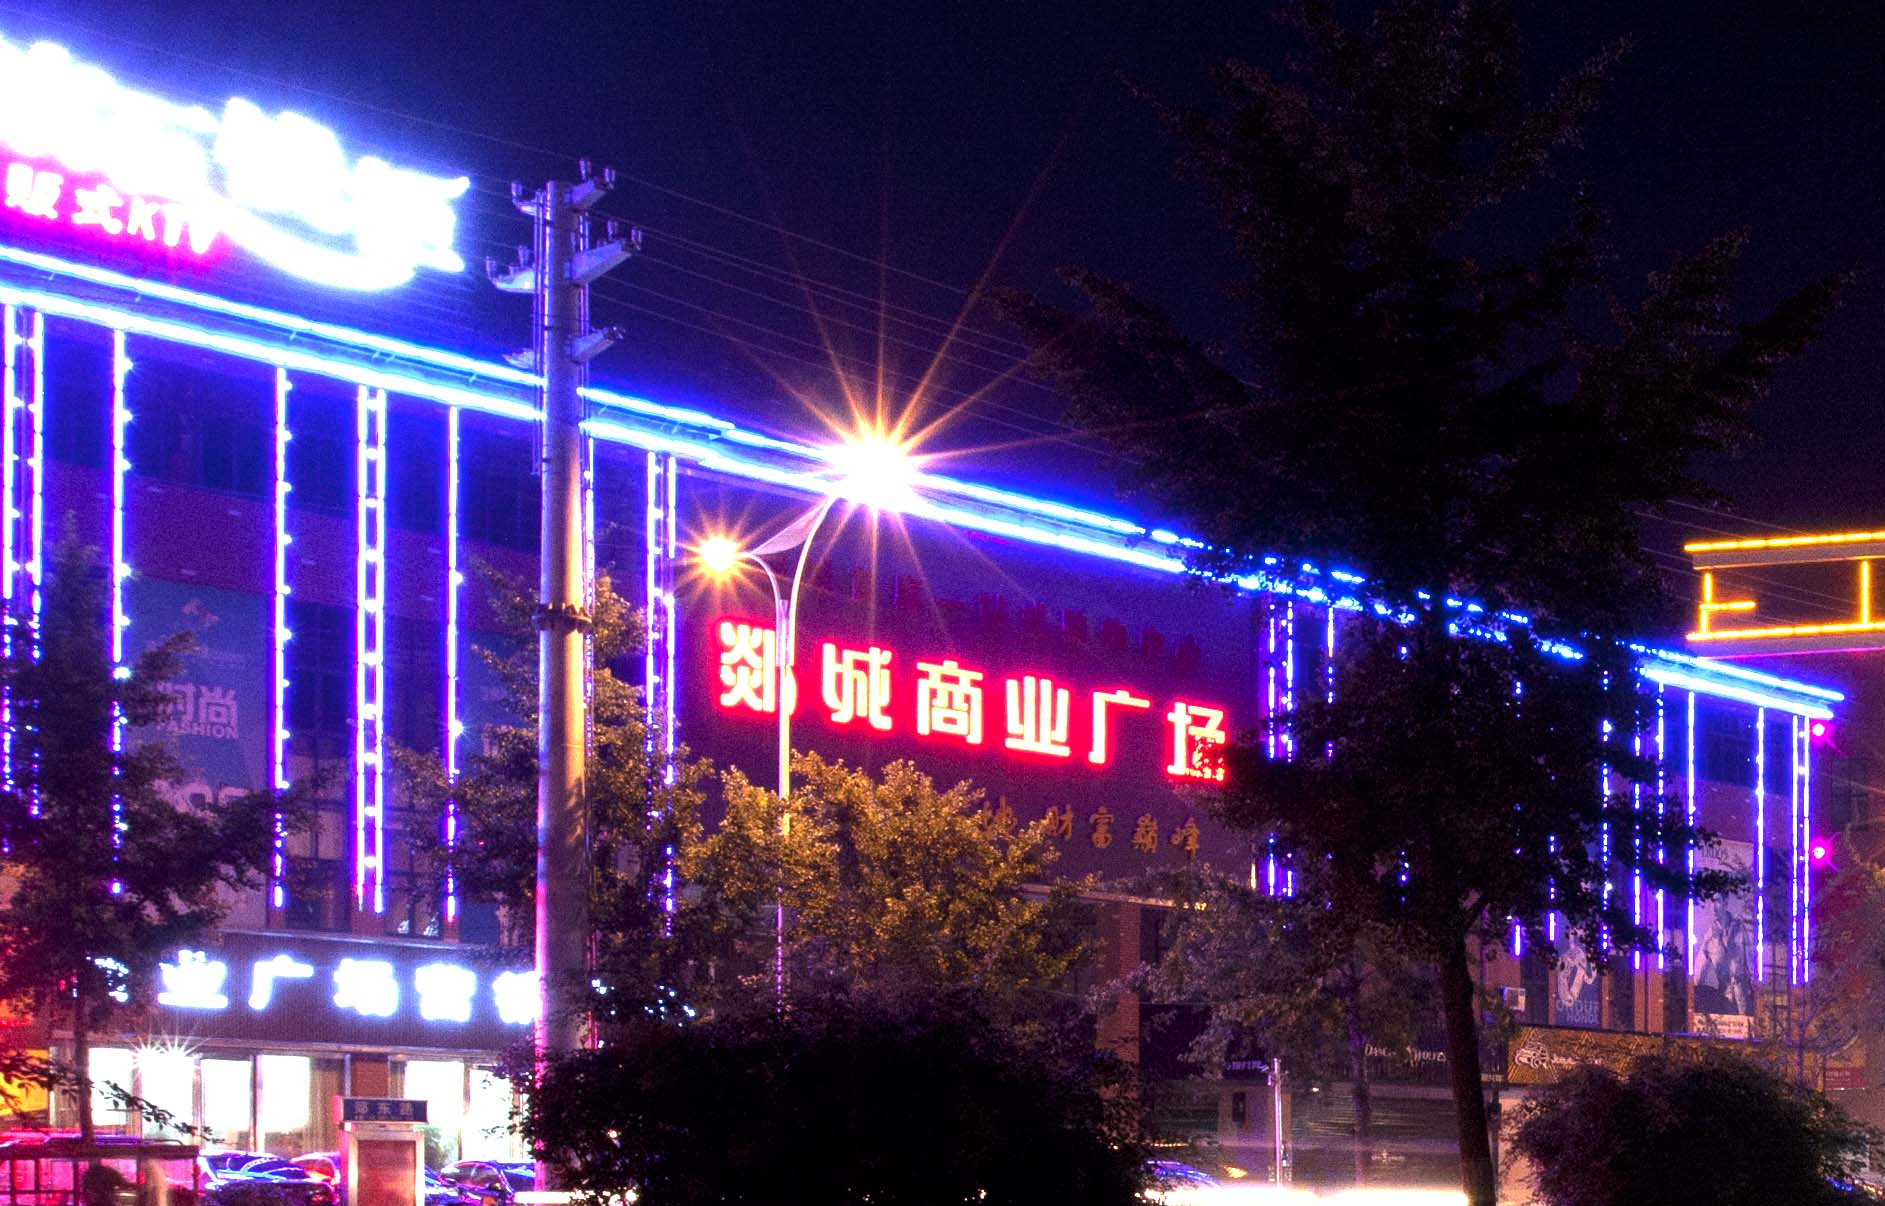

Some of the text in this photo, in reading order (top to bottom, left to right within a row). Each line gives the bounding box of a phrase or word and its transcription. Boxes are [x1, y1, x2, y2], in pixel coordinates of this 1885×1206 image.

[719, 621, 1226, 781] 郯城商业广场
